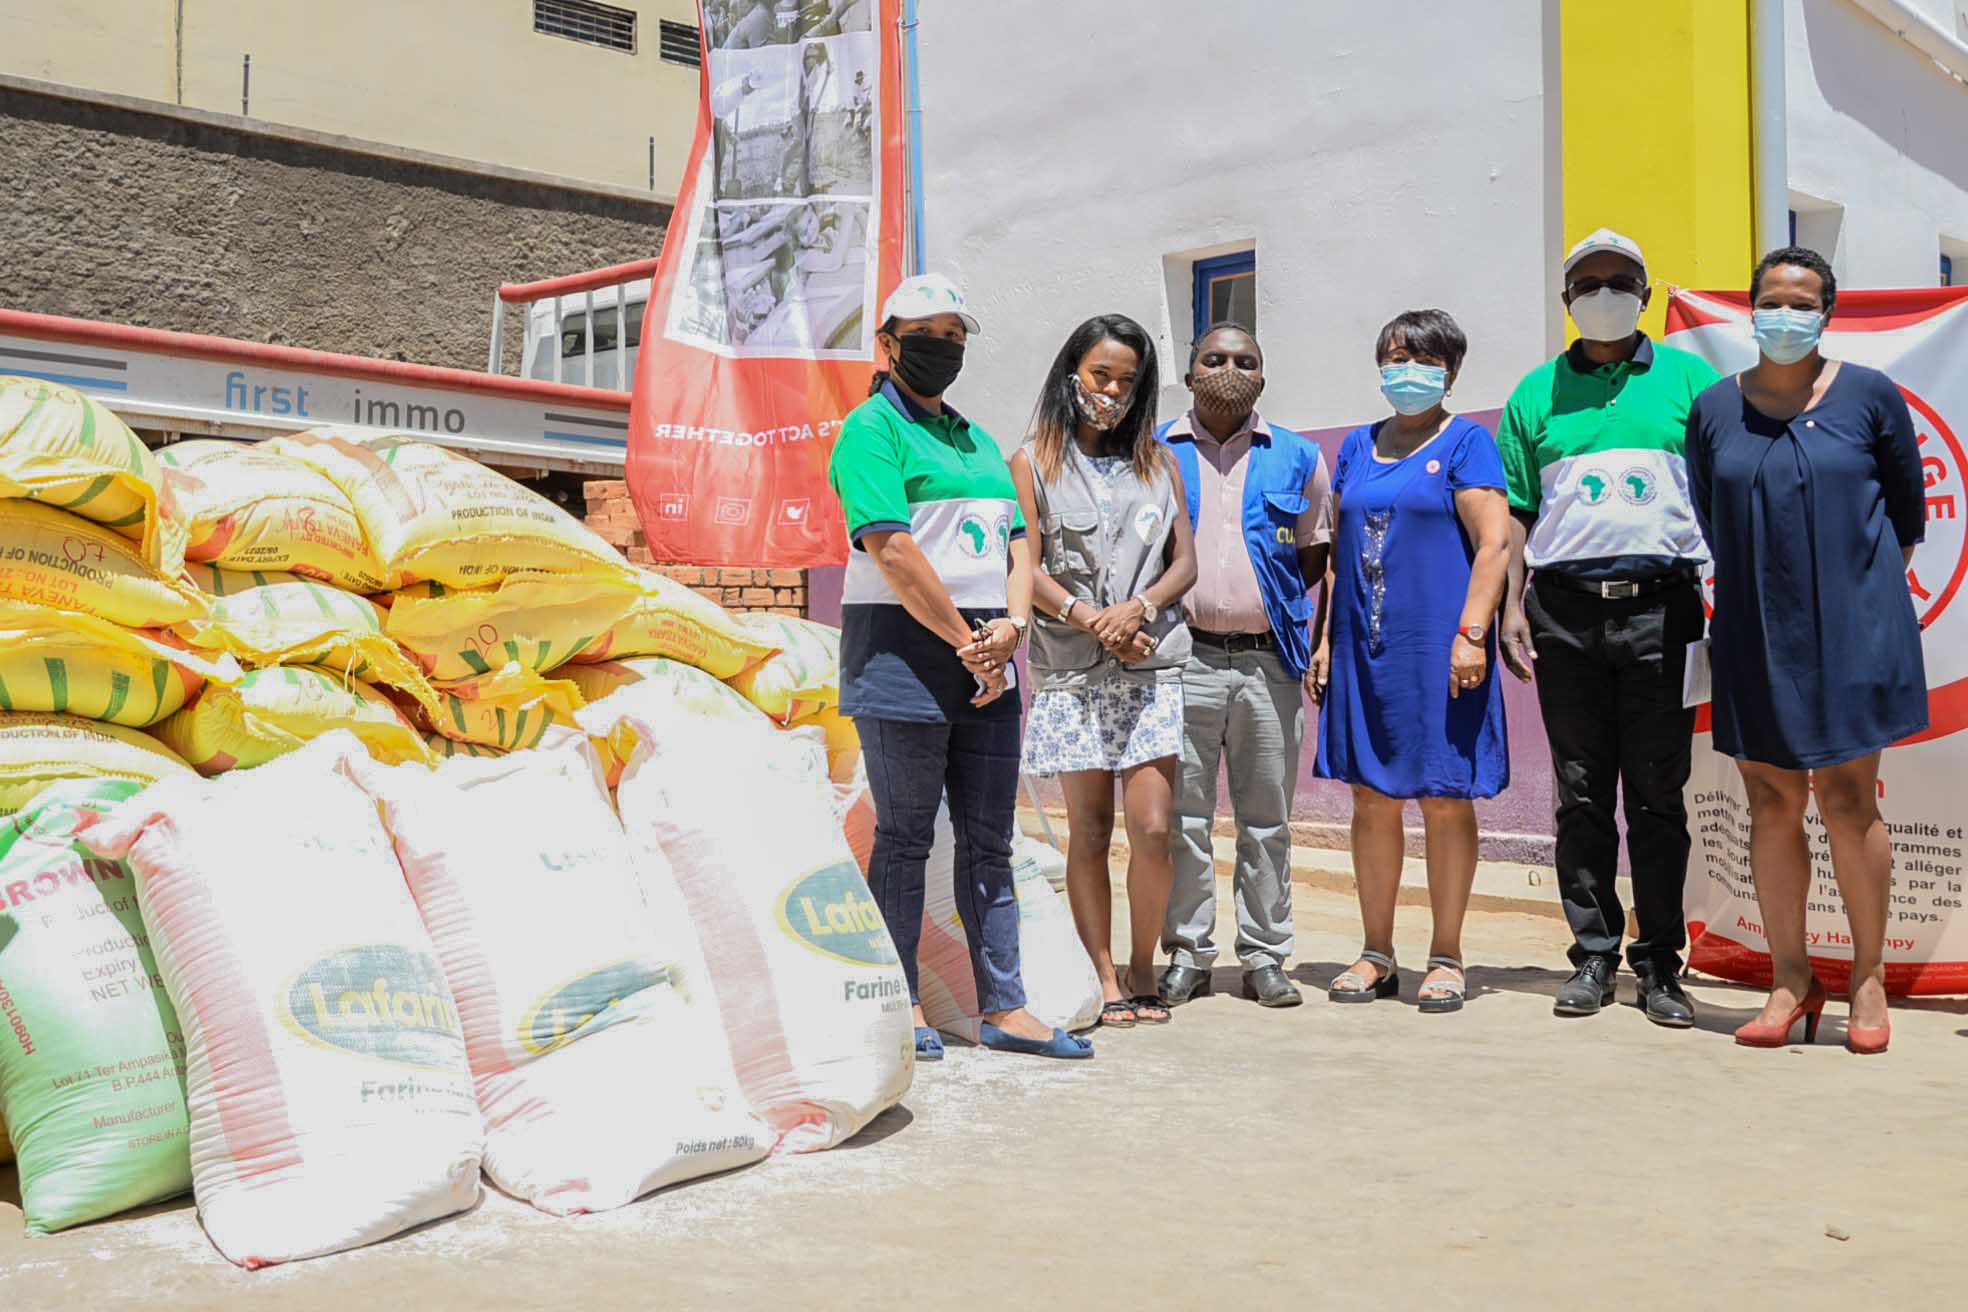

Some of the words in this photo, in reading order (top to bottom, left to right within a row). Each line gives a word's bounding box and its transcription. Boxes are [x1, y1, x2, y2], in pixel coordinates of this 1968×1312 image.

[225, 371, 310, 417] first
[354, 389, 465, 434] immo
[451, 505, 515, 521] PRODUCTION
[27, 553, 115, 590] PRODUCTION
[1702, 837, 1724, 850] les
[1945, 828, 1963, 841] et
[1889, 842, 1962, 858] rammes
[1904, 859, 1963, 877] alléger
[1908, 879, 1937, 892] par
[1948, 881, 1963, 893] la
[1931, 896, 1963, 909] des
[1807, 902, 1837, 914] ans
[1898, 911, 1945, 924] pays.
[90, 979, 131, 1003] NET
[843, 975, 901, 1002] Farine
[675, 1137, 707, 1155] Poids
